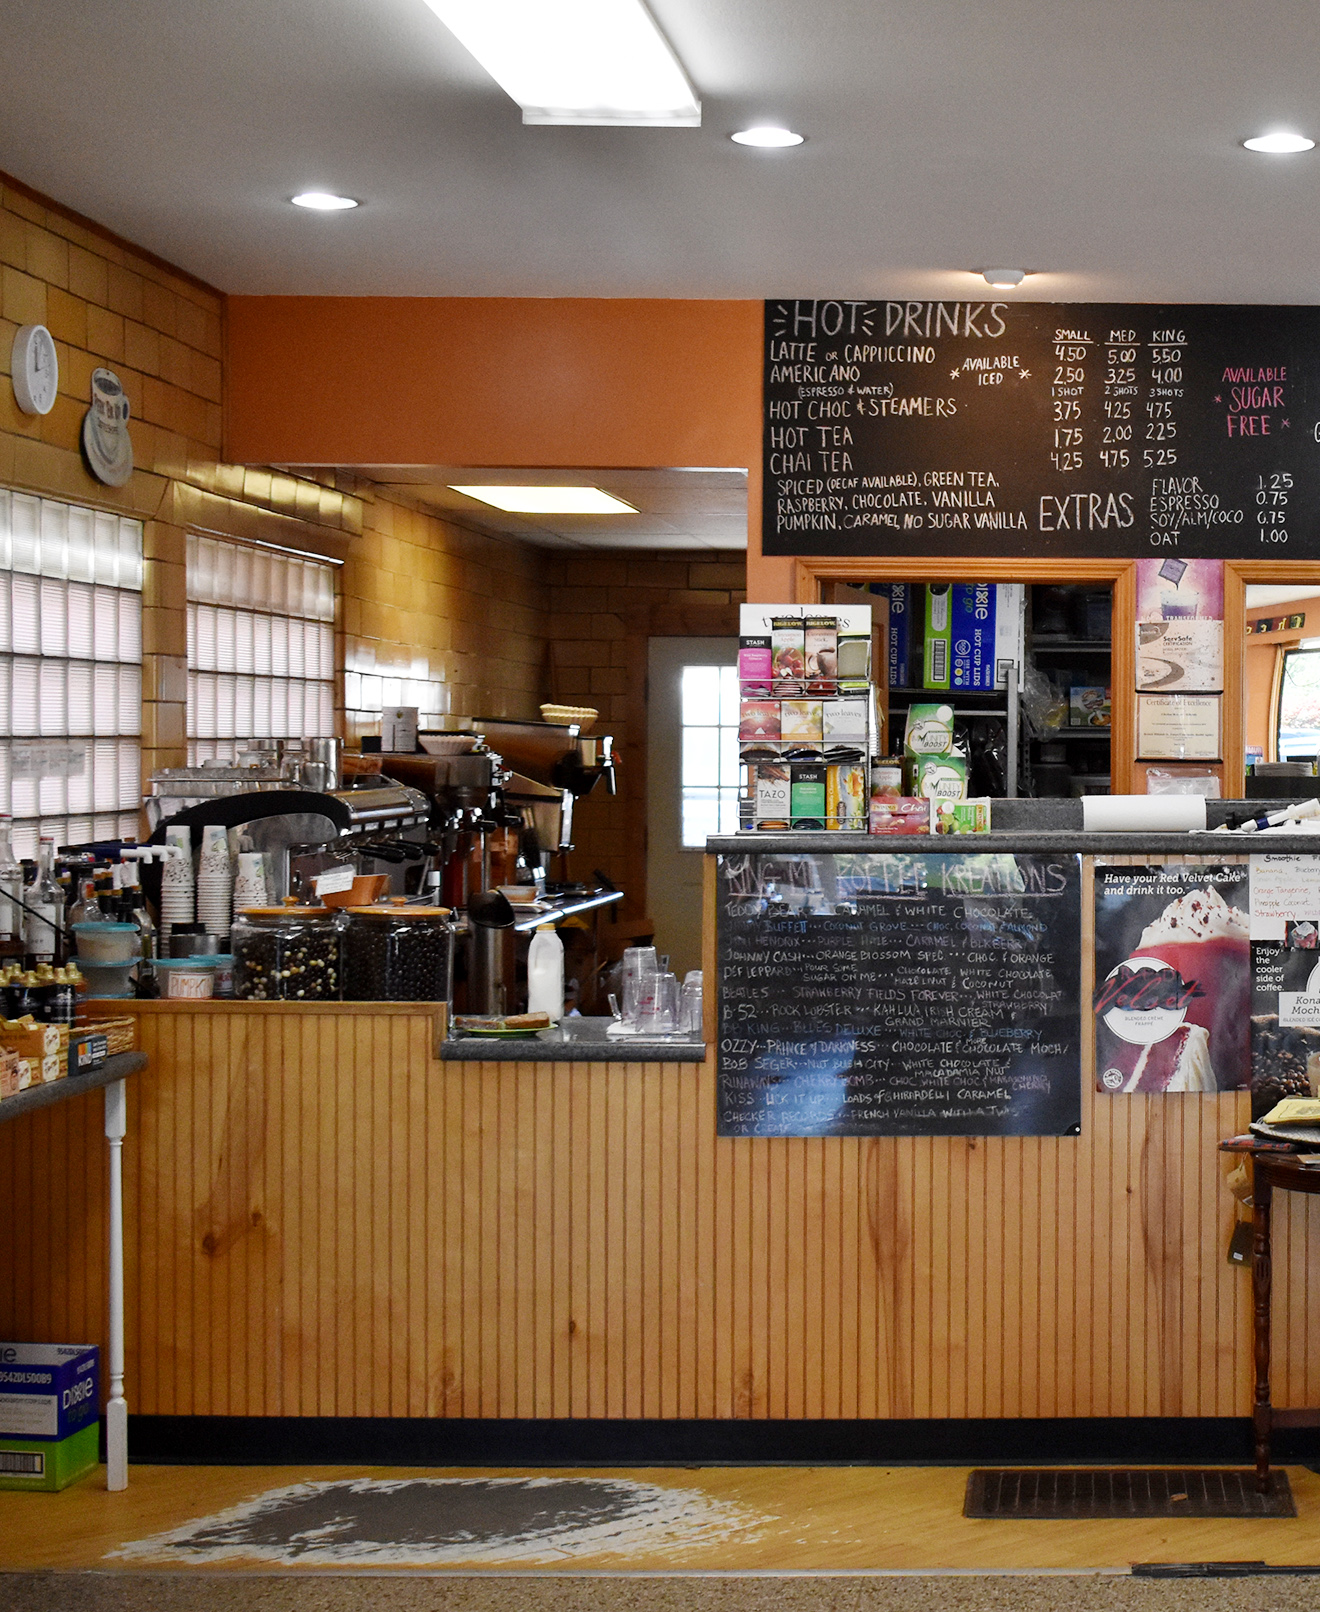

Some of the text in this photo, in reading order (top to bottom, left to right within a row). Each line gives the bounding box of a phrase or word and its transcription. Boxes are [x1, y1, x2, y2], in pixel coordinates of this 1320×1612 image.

[794, 300, 1008, 337] HOT DRINKS
[1055, 329, 1185, 342] SMALL MED KING
[770, 340, 935, 363] LATTE OR CAPPUCCINO
[1055, 345, 1181, 364] 4.50 5.00 5.50
[962, 356, 1020, 371] AVAILABLE
[770, 365, 860, 383] AMERICANO
[978, 372, 1003, 386] ICED
[1054, 367, 1182, 385] 2.50 3.25 4.00
[1222, 367, 1287, 382] AVAILABLE
[1229, 387, 1285, 412] SUGAR
[770, 401, 801, 418] HOT
[808, 400, 851, 419] CHOC
[869, 398, 957, 417] STEAMERS
[1227, 415, 1270, 437] FREE
[771, 427, 853, 448] HOT TEA
[1054, 422, 1176, 448] 1.75 2.00 2.25
[771, 452, 853, 474] CHAI TEA
[1051, 449, 1177, 471] 4.25 4.75 5.25
[1153, 473, 1293, 495] FLAVOR 1.25
[1150, 491, 1287, 513] ESPRESSO 0.75
[1039, 493, 1134, 531] EXTRAS
[1150, 510, 1285, 529] SOY/ALM/COCO 0.75
[1150, 529, 1288, 545] OAT 1.00
[973, 667, 981, 686] LIDS
[759, 790, 786, 799] TAZO
[901, 804, 926, 812] Chai
[1104, 872, 1241, 887] Have your Red Velvet Cake
[1104, 885, 1187, 895] and drink it too.
[724, 949, 771, 963] JOHNNY
[1256, 948, 1280, 956] Enjoy
[1256, 956, 1270, 964] the
[1256, 965, 1283, 974] cooler
[962, 978, 1014, 990] COCONUT
[1256, 974, 1285, 982] side of
[793, 987, 905, 1000] STRAWBERRY FIELDS
[1256, 983, 1285, 992] coffee.
[804, 1004, 1004, 1020] LOBSTER CREAM
[980, 1028, 1042, 1041] BLUEBERRY
[892, 1041, 954, 1054] CHOCOLATE
[957, 1088, 1012, 1100] CARAMEL
[62, 1376, 94, 1411] Dixie
